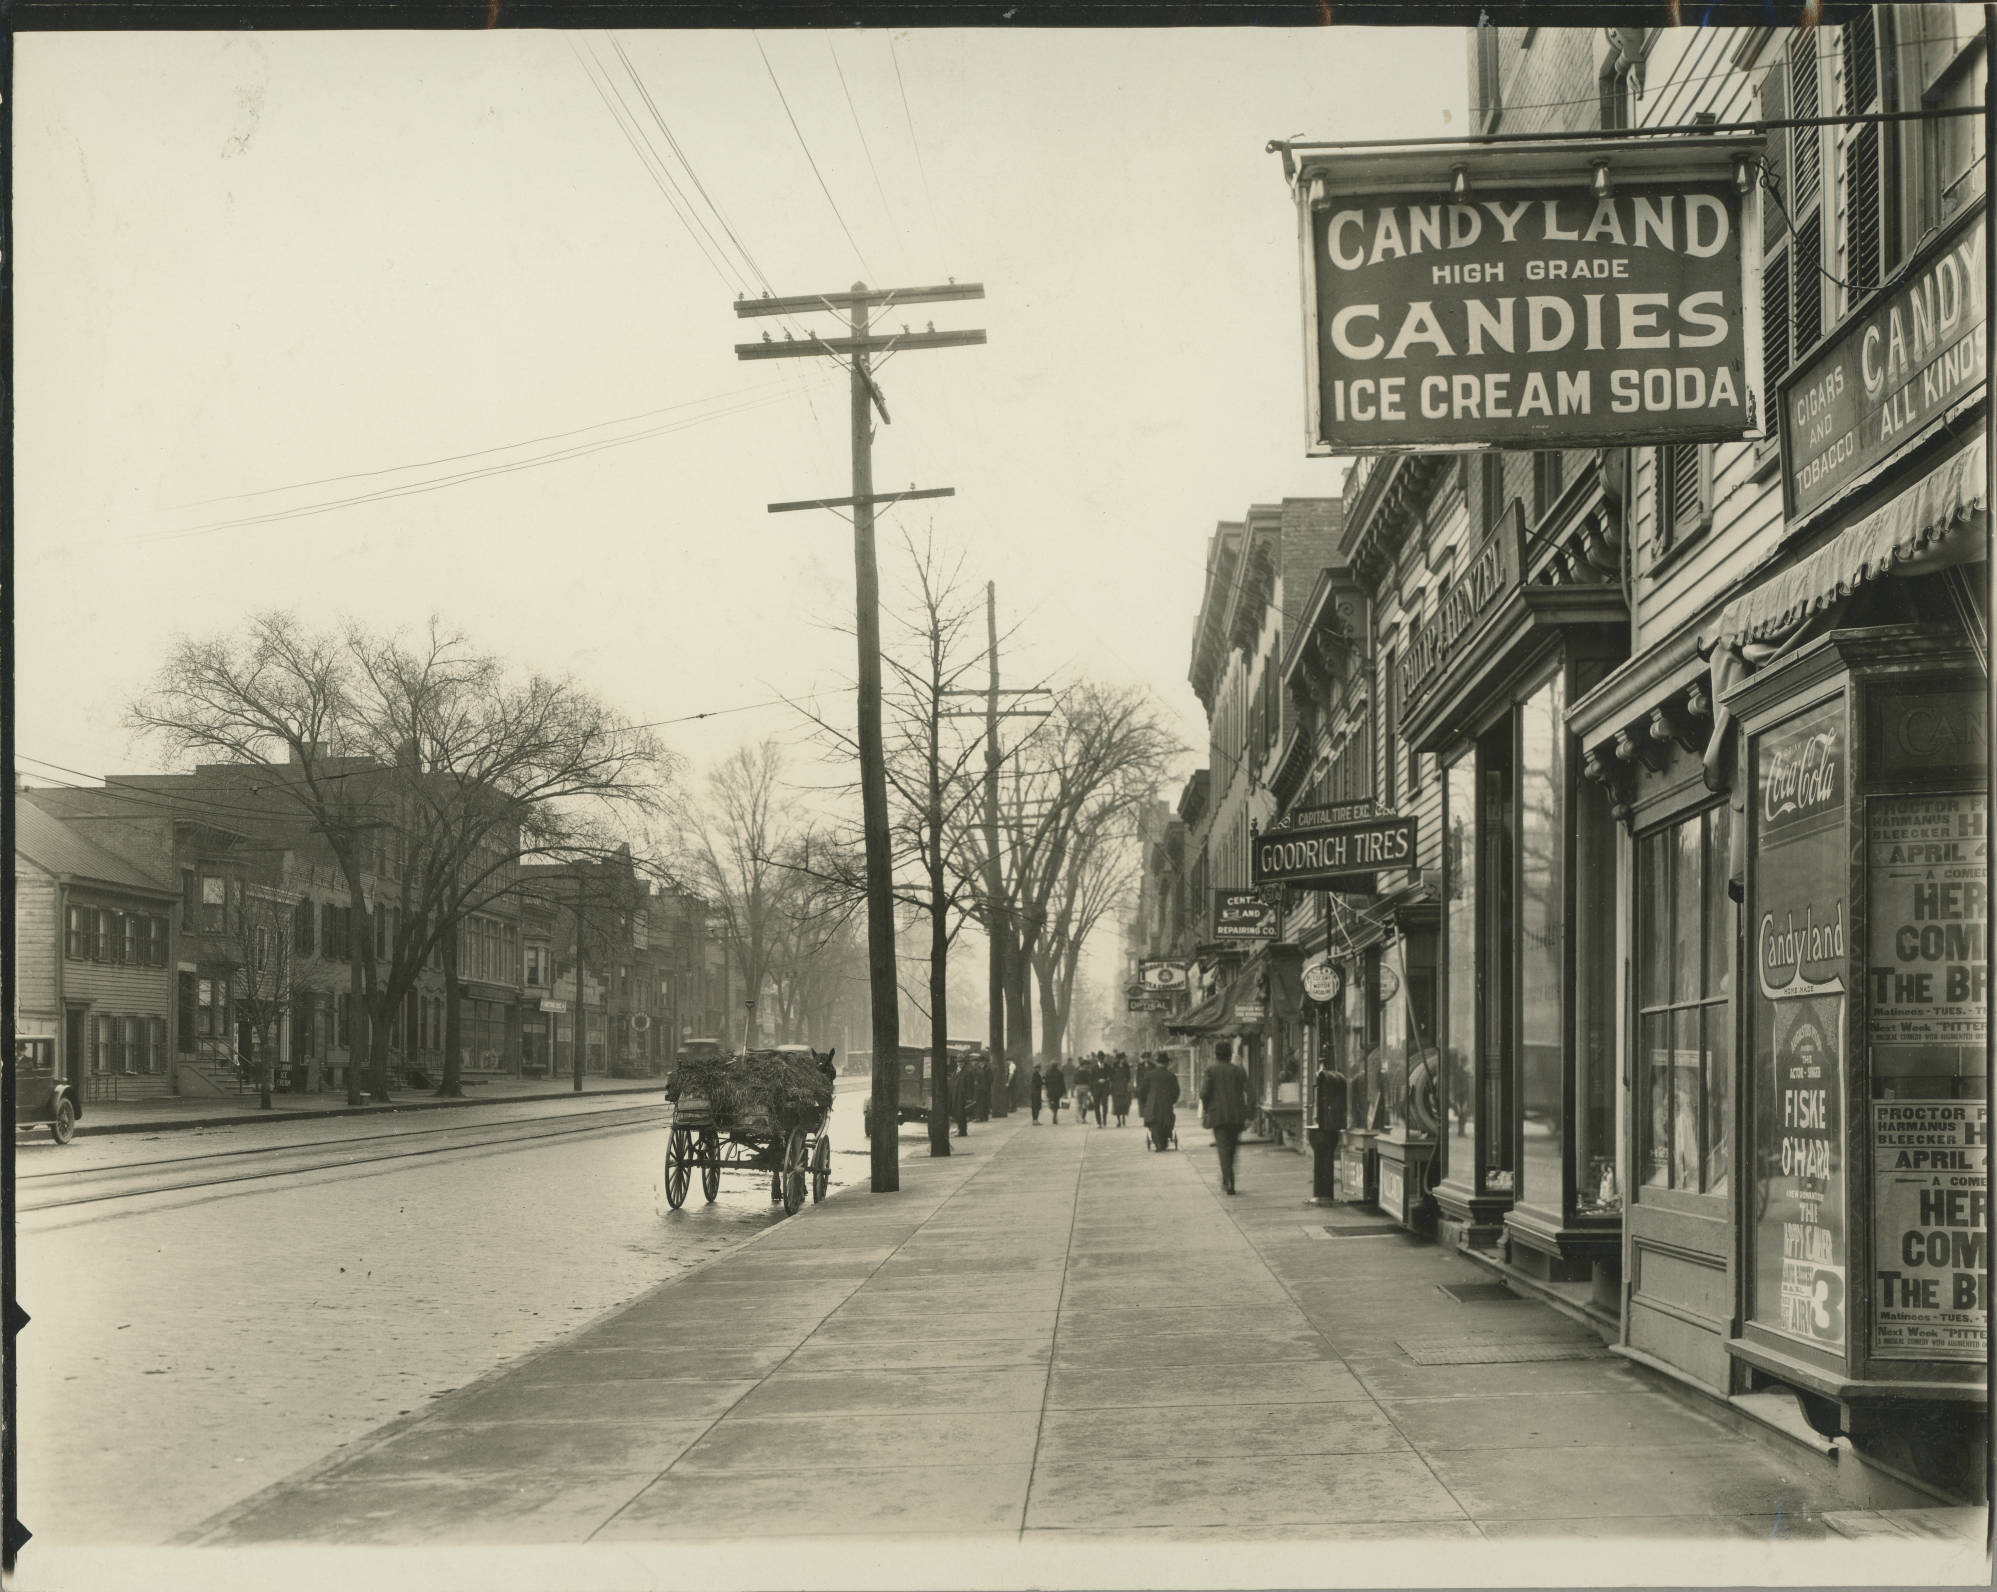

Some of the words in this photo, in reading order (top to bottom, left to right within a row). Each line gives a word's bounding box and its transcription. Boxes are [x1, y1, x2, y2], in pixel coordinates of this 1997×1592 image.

[1327, 194, 1729, 271] CANDYLAND
[1432, 261, 1505, 285] HIGH
[1525, 259, 1630, 280] GRADE
[1330, 290, 1730, 360] CANDIES
[1881, 383, 1916, 441] ALL
[1924, 322, 1987, 409] KINDS
[1333, 376, 1406, 422] ICE
[1420, 370, 1592, 420] CREAM
[1610, 366, 1740, 414] SODA
[1797, 365, 1844, 427] CIGARS
[1810, 413, 1832, 449] AND
[1795, 431, 1854, 495] TOBACCO
[1298, 811, 1331, 826] CAPITAL
[1332, 807, 1352, 821] TIRE
[1872, 815, 1950, 827] HARMANUS
[1872, 828, 1950, 840] BLEECKER
[1261, 836, 1347, 872] GOODRICH
[1354, 828, 1409, 864] TIRES
[1889, 843, 1967, 864] APRIL
[1926, 869, 1935, 879] A
[1914, 881, 1987, 920] HER
[1241, 909, 1260, 918] AND
[1217, 926, 1260, 935] REPAIRING
[1262, 927, 1277, 935] CO.
[1759, 899, 1845, 998] Candyland
[1799, 985, 1815, 993] MADE
[1871, 966, 1933, 1004] THE
[1873, 1007, 1924, 1016] Matinees
[1933, 1006, 1967, 1016] TUES.
[1870, 1022, 1896, 1032] Next
[1900, 1021, 1931, 1032] Week
[1785, 1089, 1826, 1129] FISKE
[1878, 1107, 1965, 1120] PROCTOR
[1878, 1121, 1956, 1131] HARMANUS
[1878, 1134, 1956, 1144] BLEECKER
[1781, 1136, 1830, 1180] O'HARA
[1895, 1150, 1973, 1169] APRIL
[1932, 1176, 1940, 1186] A
[1877, 1271, 1940, 1308] THE
[1811, 1269, 1844, 1341] 3
[1880, 1311, 1930, 1321] Matinees
[1939, 1313, 1973, 1323] TUES.
[1878, 1326, 1903, 1336] Next
[1907, 1326, 1938, 1337] Week
